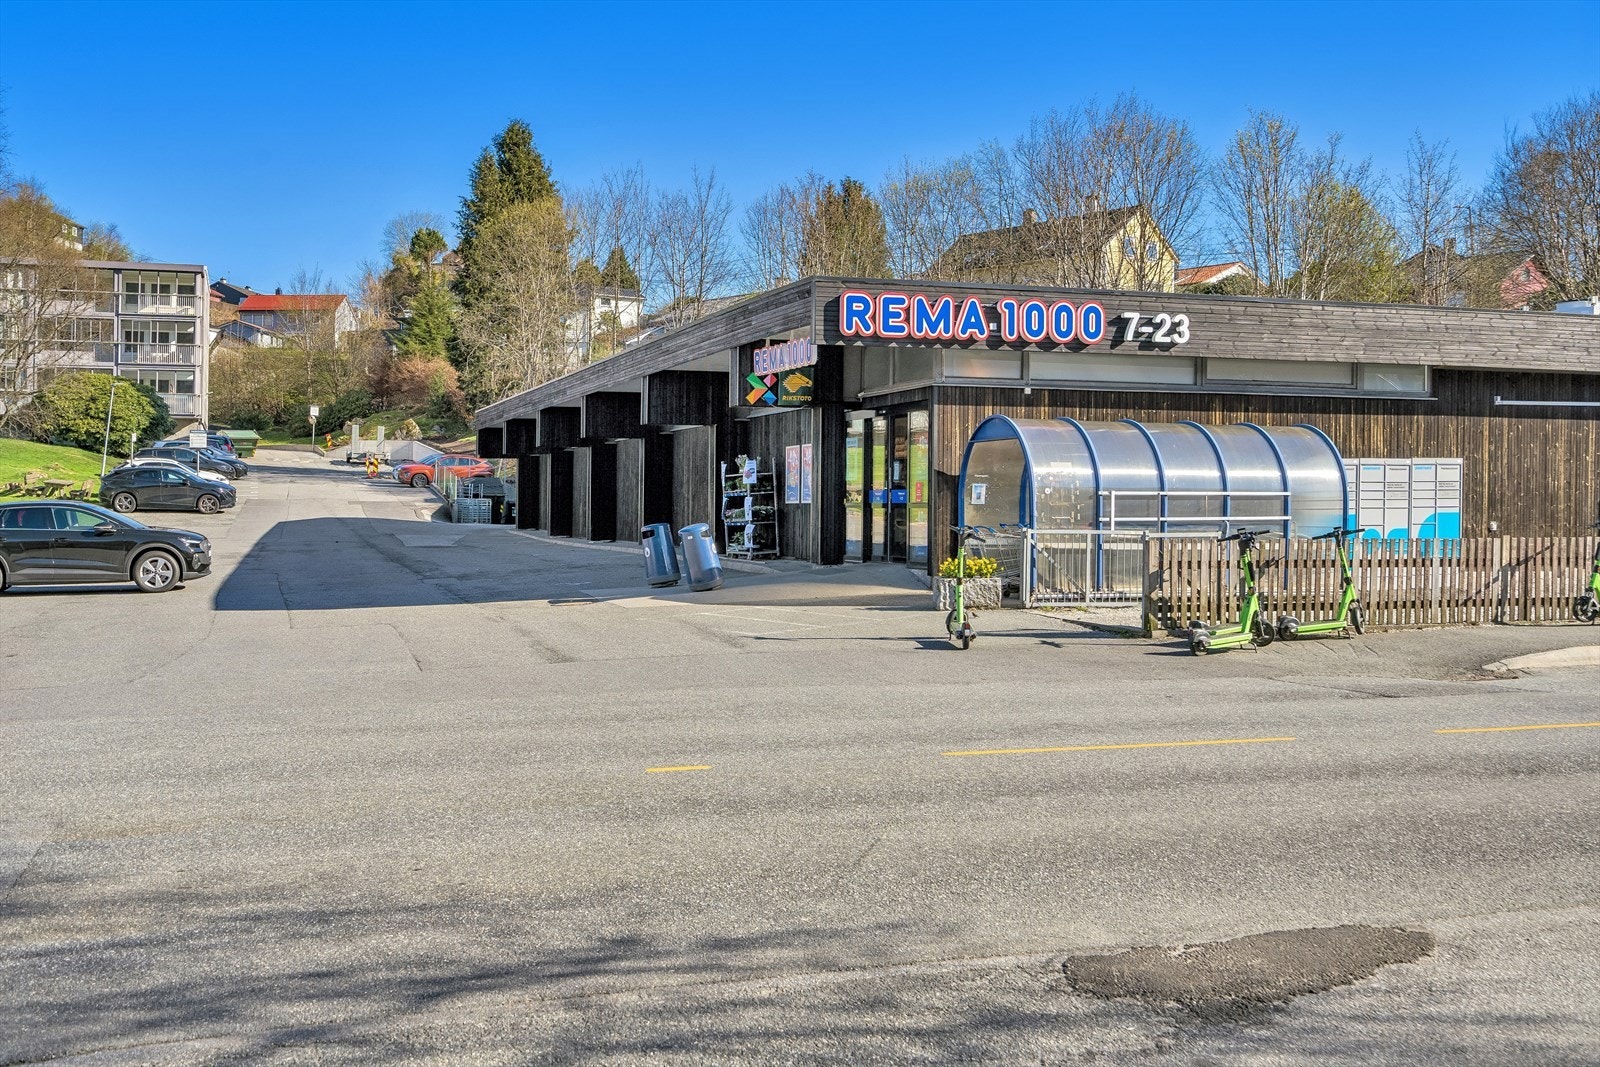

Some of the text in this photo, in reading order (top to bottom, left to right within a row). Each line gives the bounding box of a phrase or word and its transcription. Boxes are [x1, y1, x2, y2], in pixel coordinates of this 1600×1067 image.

[841, 291, 1105, 344] REMA 1000
[1121, 312, 1190, 344] 7-23
[754, 337, 811, 374] REMA 1000
